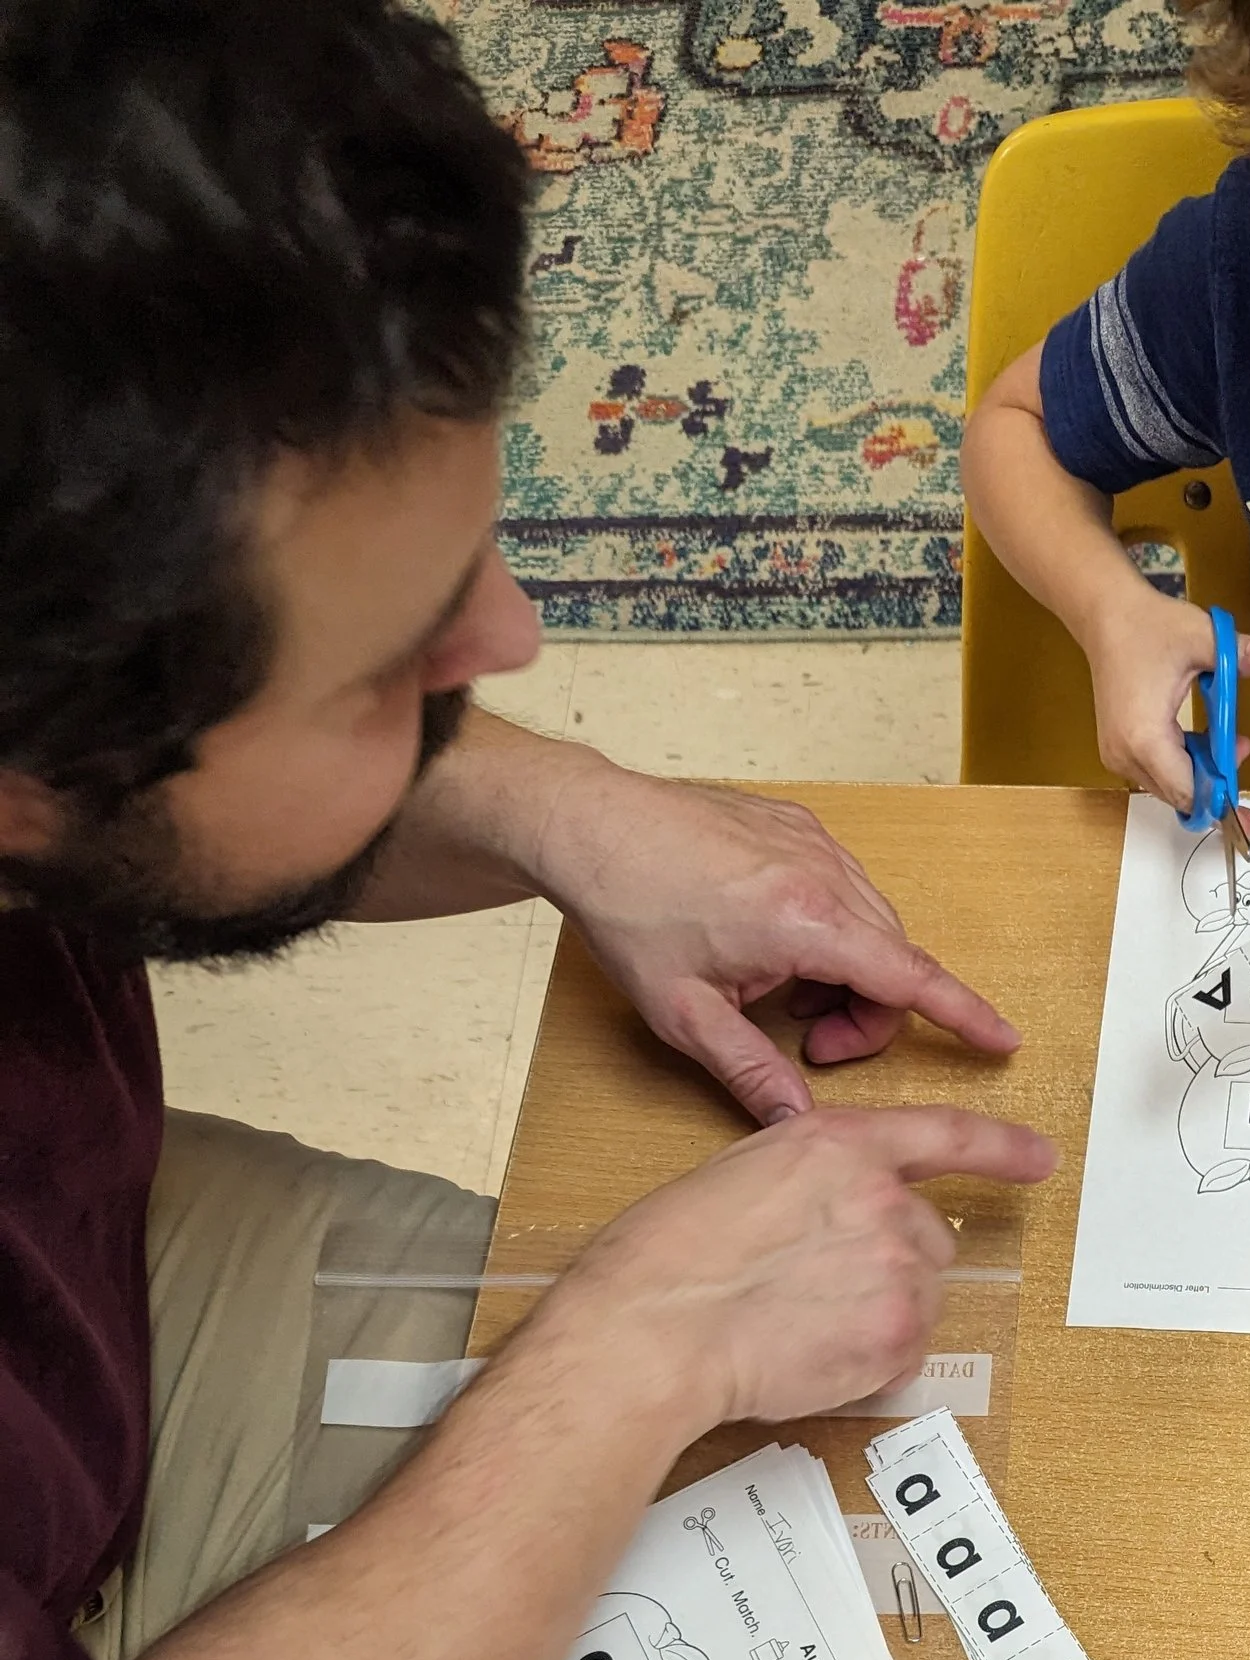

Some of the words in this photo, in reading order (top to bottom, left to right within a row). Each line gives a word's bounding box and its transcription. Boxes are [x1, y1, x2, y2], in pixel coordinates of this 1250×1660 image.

[1192, 967, 1232, 1011] A
[1123, 1281, 1183, 1292] Discrimination
[1185, 1283, 1210, 1293] Letter
[744, 1484, 766, 1516] Name
[895, 1473, 941, 1517] a
[936, 1537, 983, 1581] a
[978, 1599, 1024, 1643] a
[715, 1556, 736, 1586] Cut.
[731, 1590, 761, 1638] Match.
